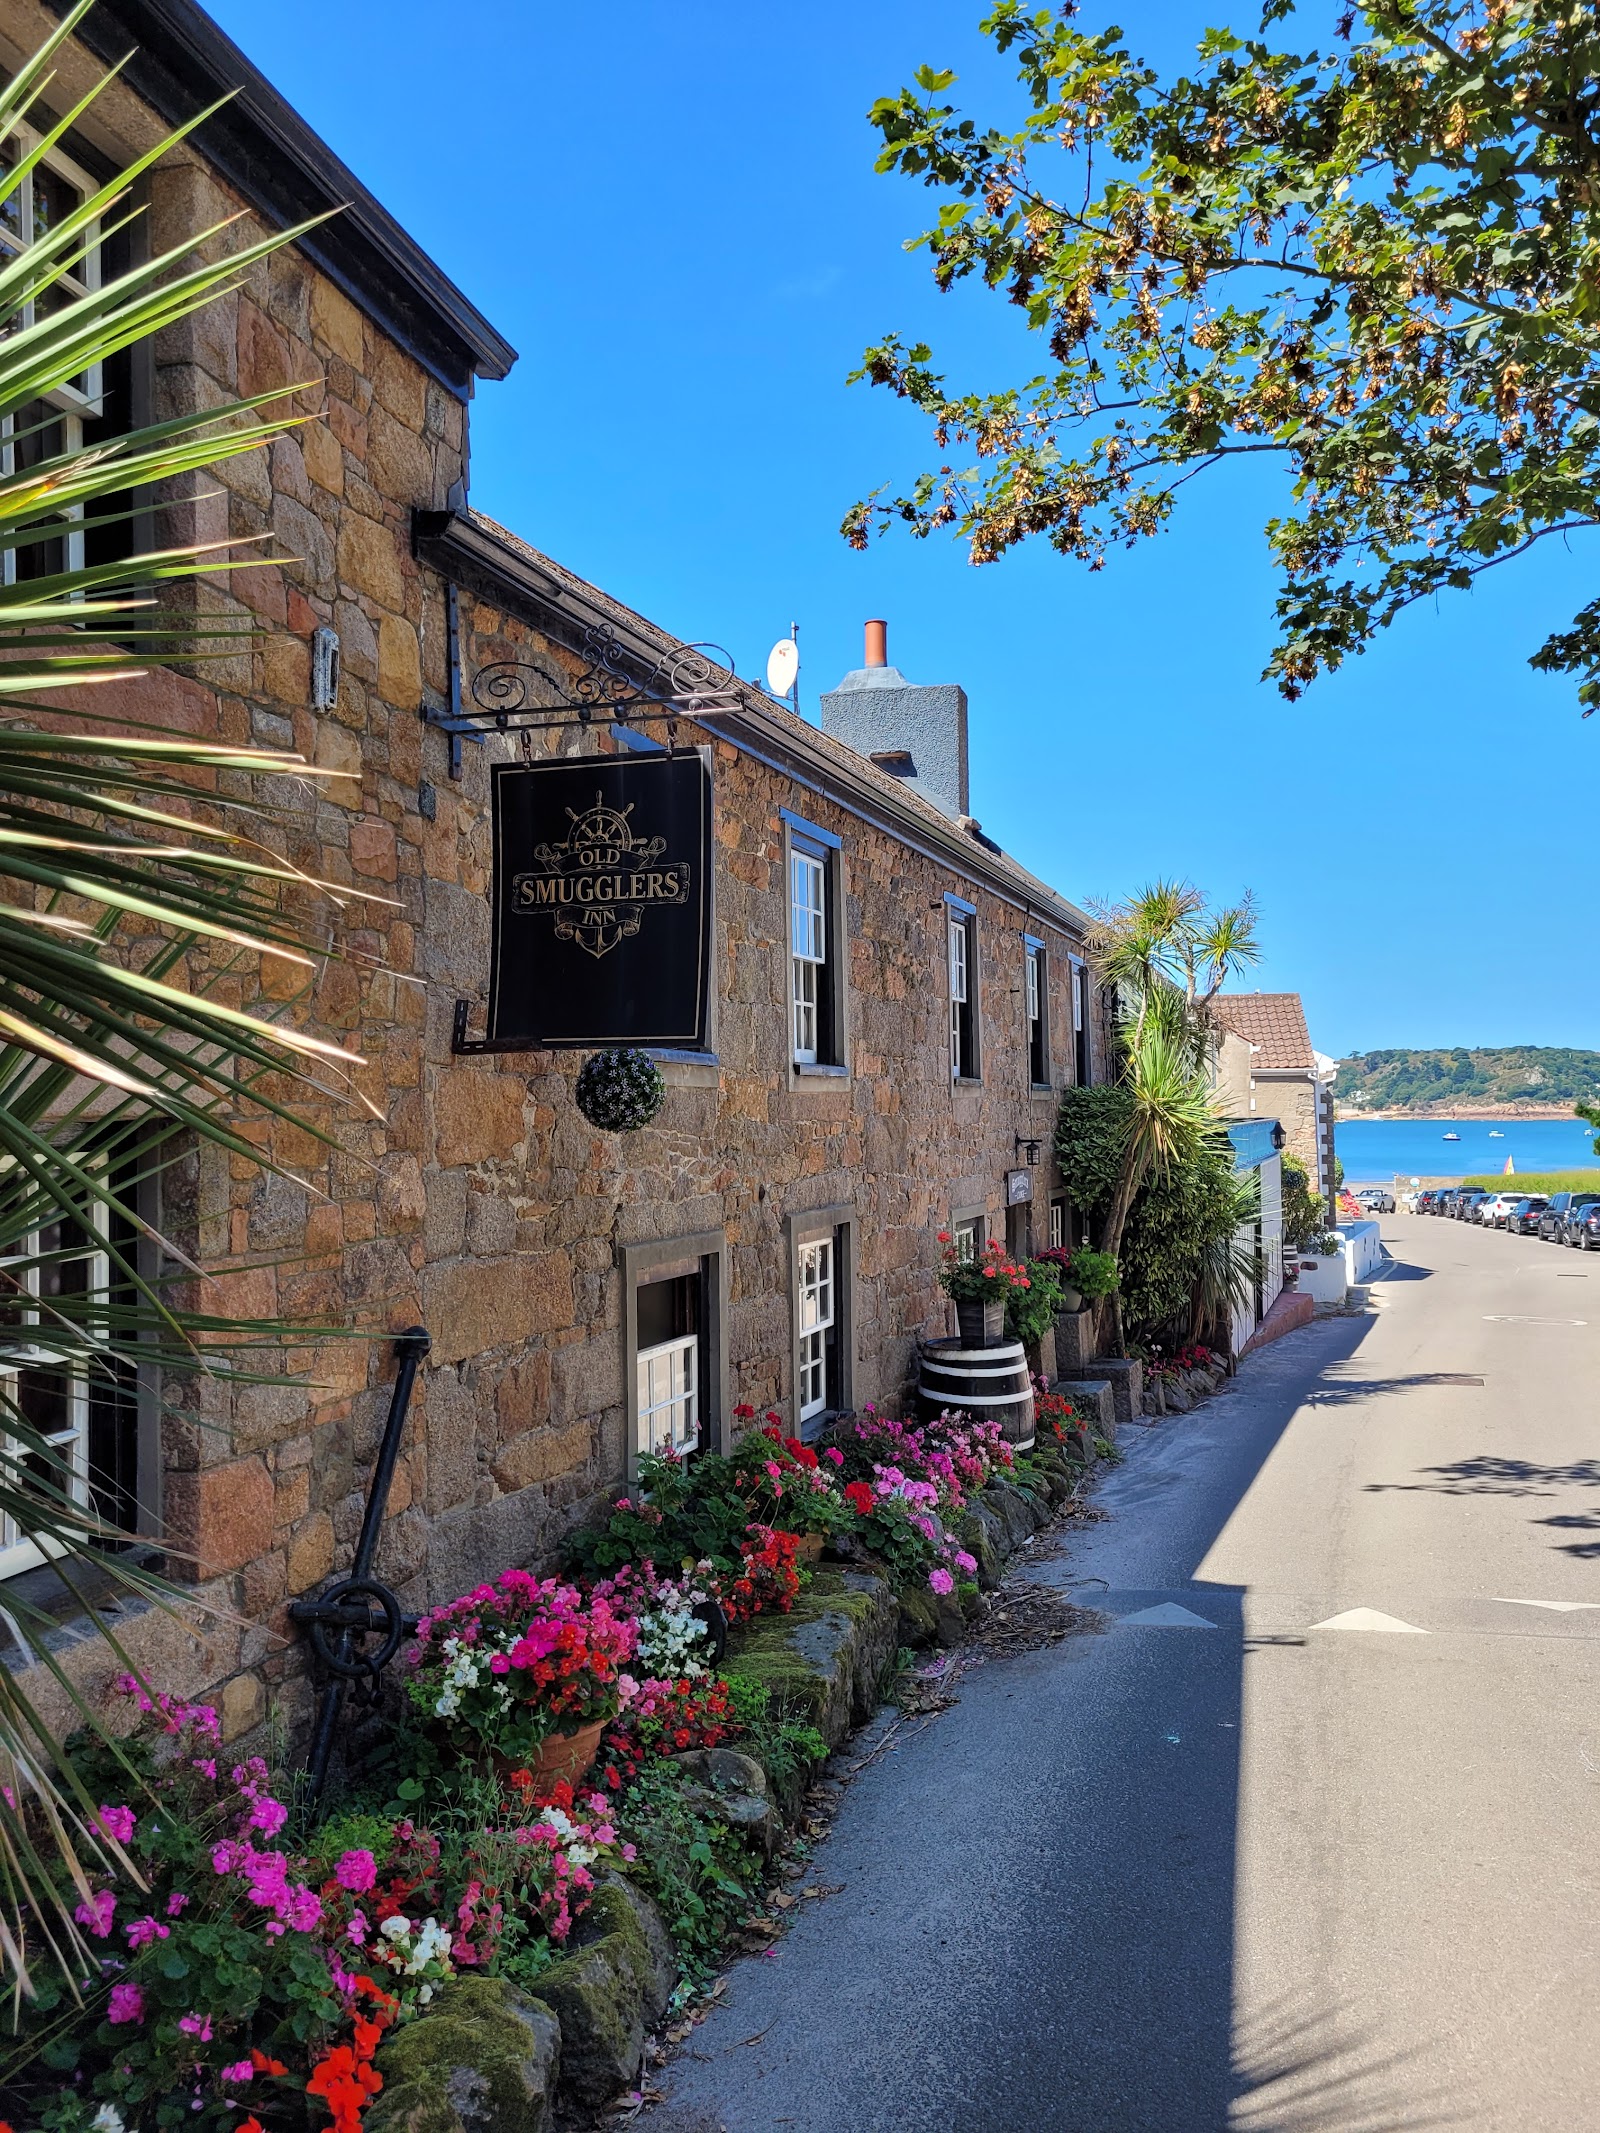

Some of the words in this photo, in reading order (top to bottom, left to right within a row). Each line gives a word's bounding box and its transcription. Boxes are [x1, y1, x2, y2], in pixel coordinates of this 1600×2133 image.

[579, 848, 620, 866] OLD
[520, 872, 680, 905] SMUGGLERS
[582, 909, 617, 925] INN
